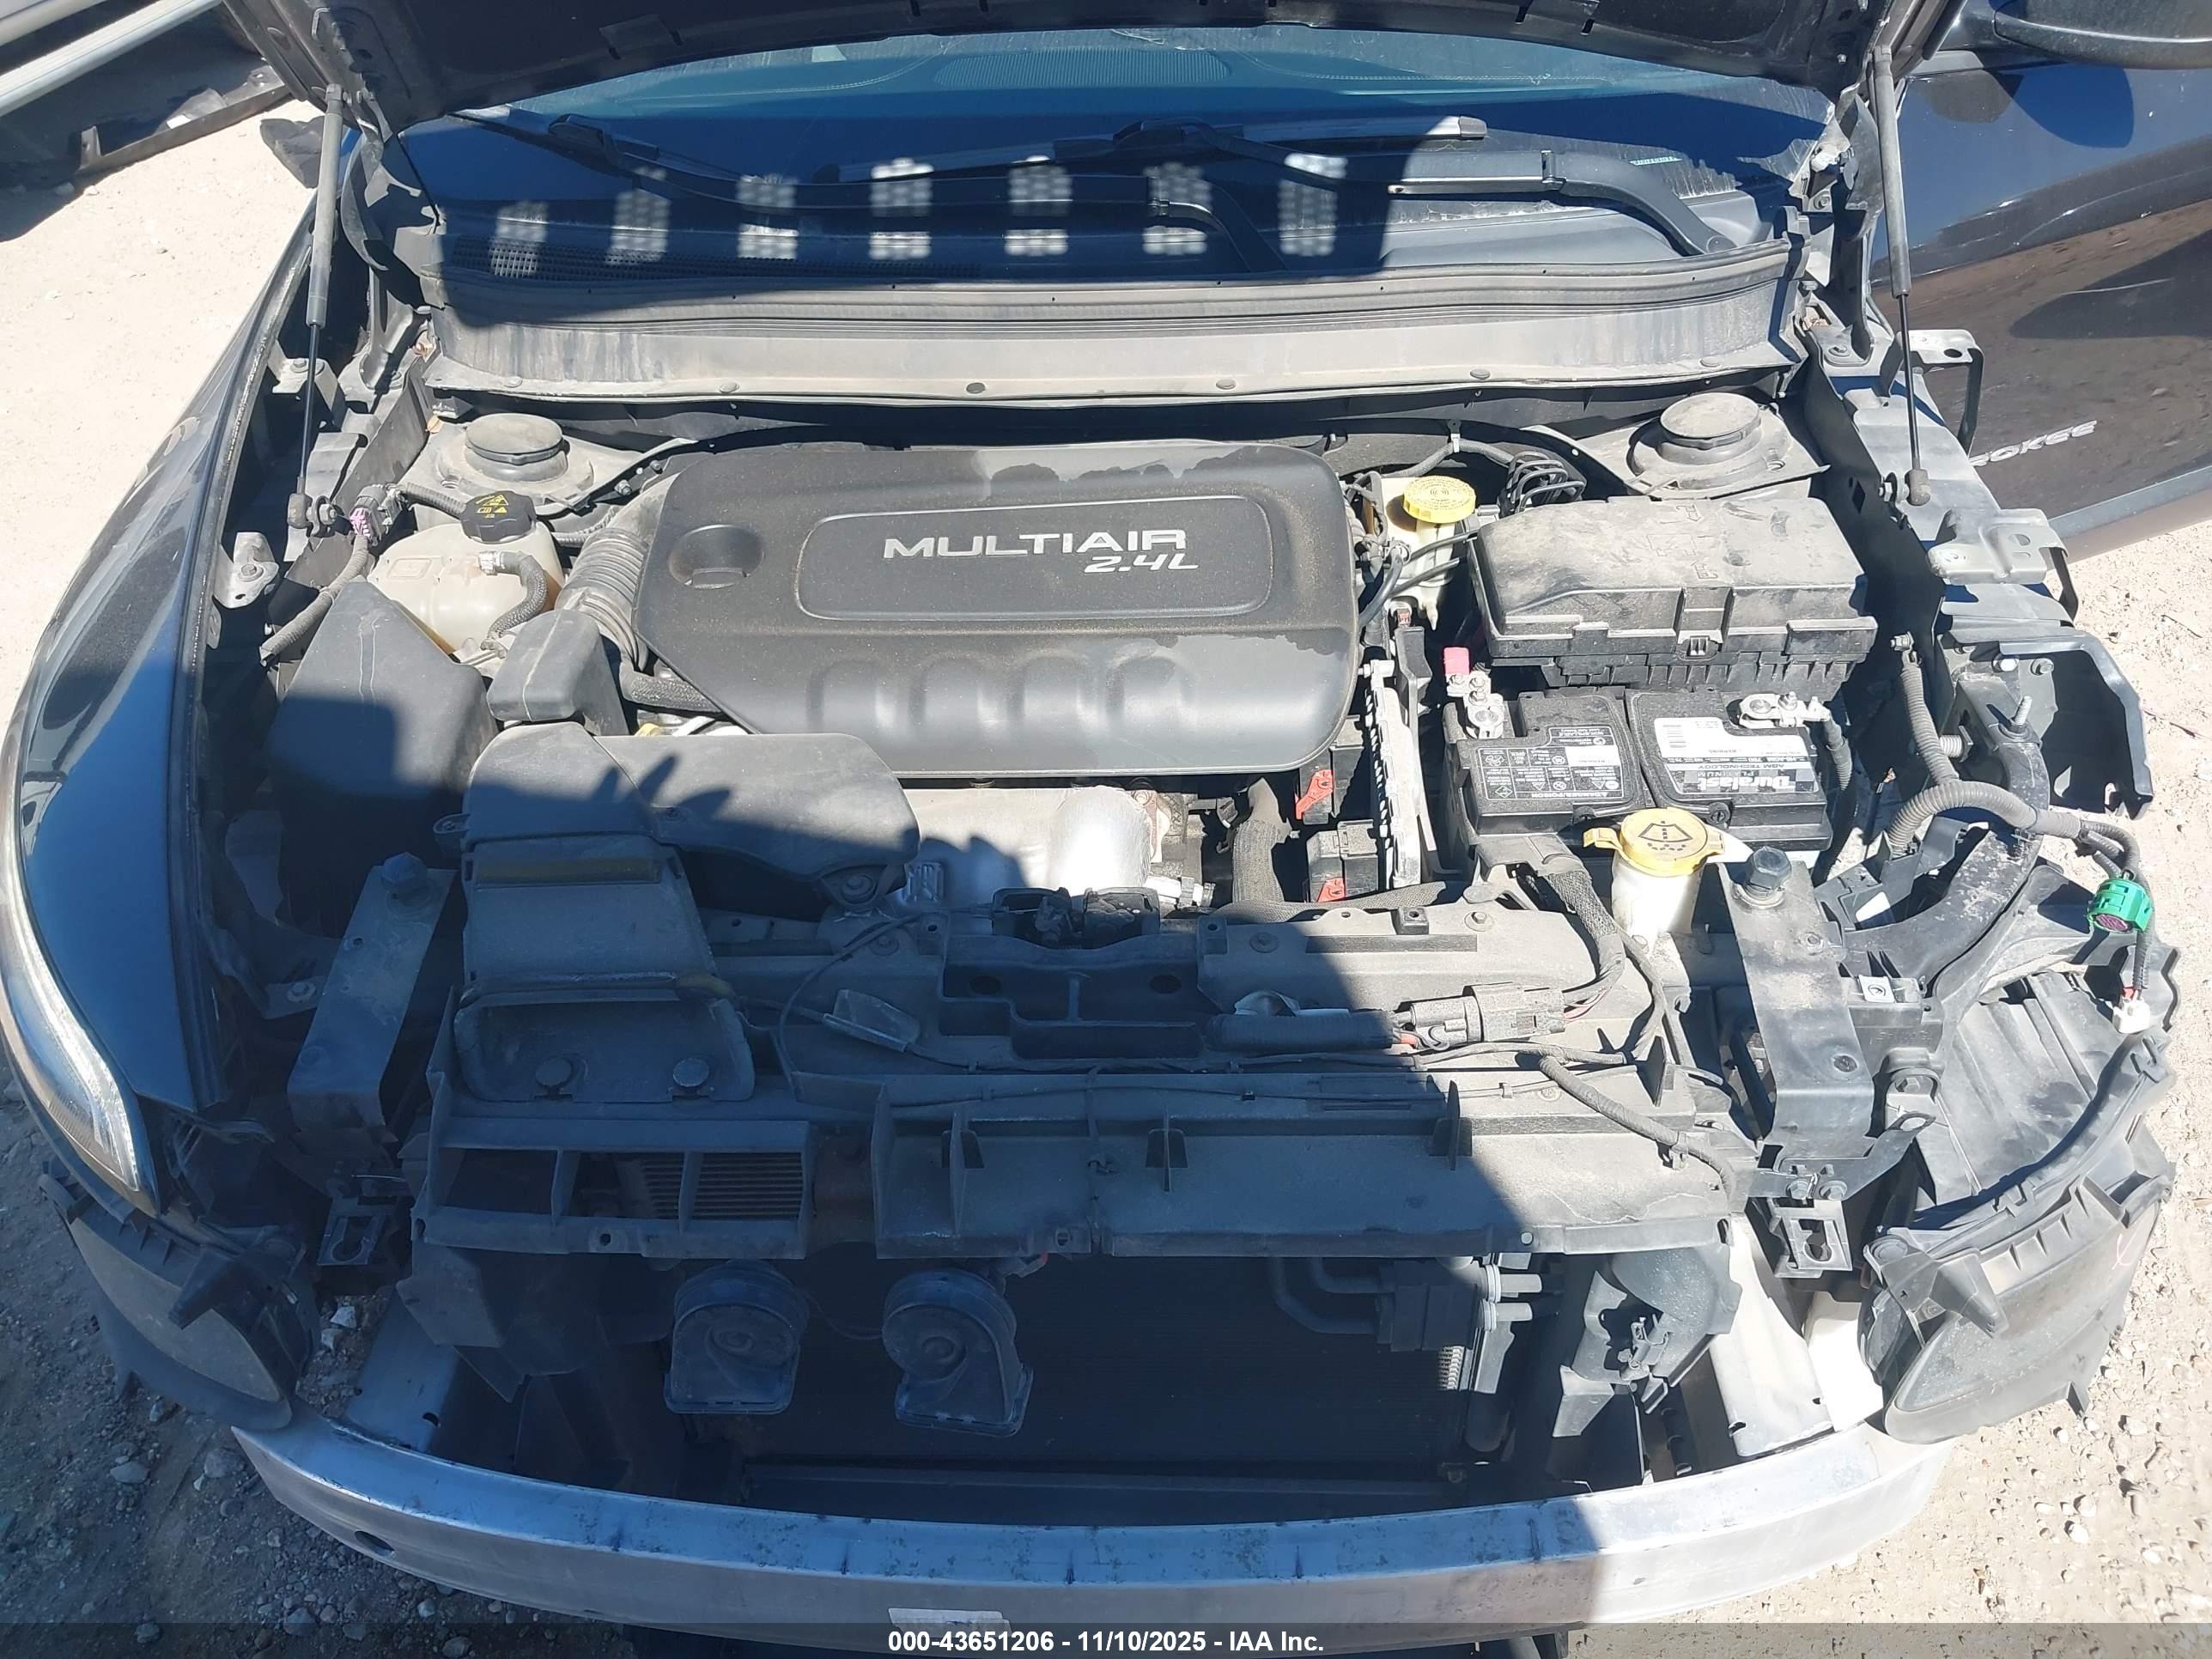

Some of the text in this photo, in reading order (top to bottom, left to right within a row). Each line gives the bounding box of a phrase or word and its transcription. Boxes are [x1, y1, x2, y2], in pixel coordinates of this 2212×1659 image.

[1967, 420, 2098, 467] ROKEE
[883, 529, 1187, 559] MULTIAIR
[1084, 553, 1199, 573] 2.4L
[1697, 775, 1796, 791] Duralast
